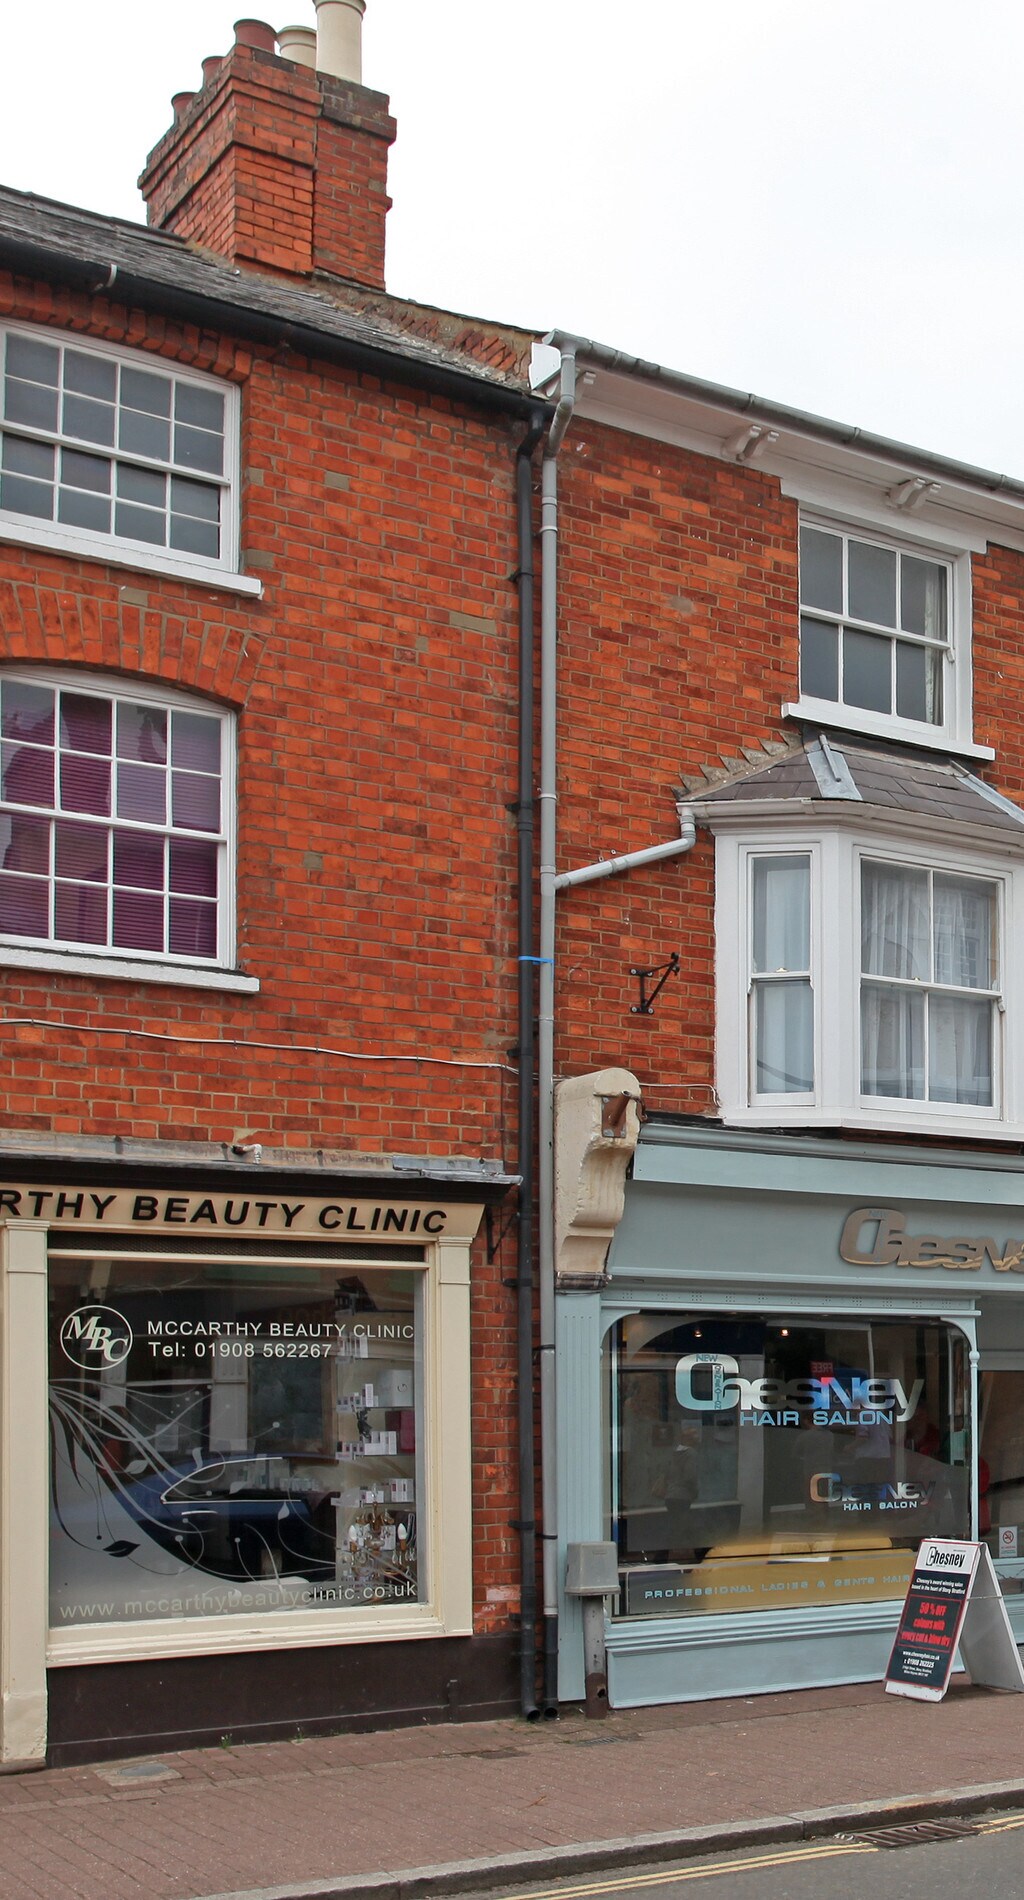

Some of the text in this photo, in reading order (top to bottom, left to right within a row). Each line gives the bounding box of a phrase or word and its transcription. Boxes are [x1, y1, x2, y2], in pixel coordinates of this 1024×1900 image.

[132, 1196, 305, 1227] BEAUTY
[318, 1205, 447, 1233] CLINIC
[148, 1321, 414, 1338] MCCARTHY BEAUTY CLINIC
[148, 1342, 332, 1358] Tel: 01908 562267
[695, 1354, 718, 1362] NEW
[740, 1410, 893, 1426] HAIR SALON
[843, 1501, 917, 1511] HAIR SALON
[644, 1584, 754, 1599] PROFESSIONAL
[762, 1581, 808, 1592] LADIES
[834, 1576, 876, 1587] GENTS
[60, 1581, 416, 1618] www.mccarthybeautyclinic.co.uk
